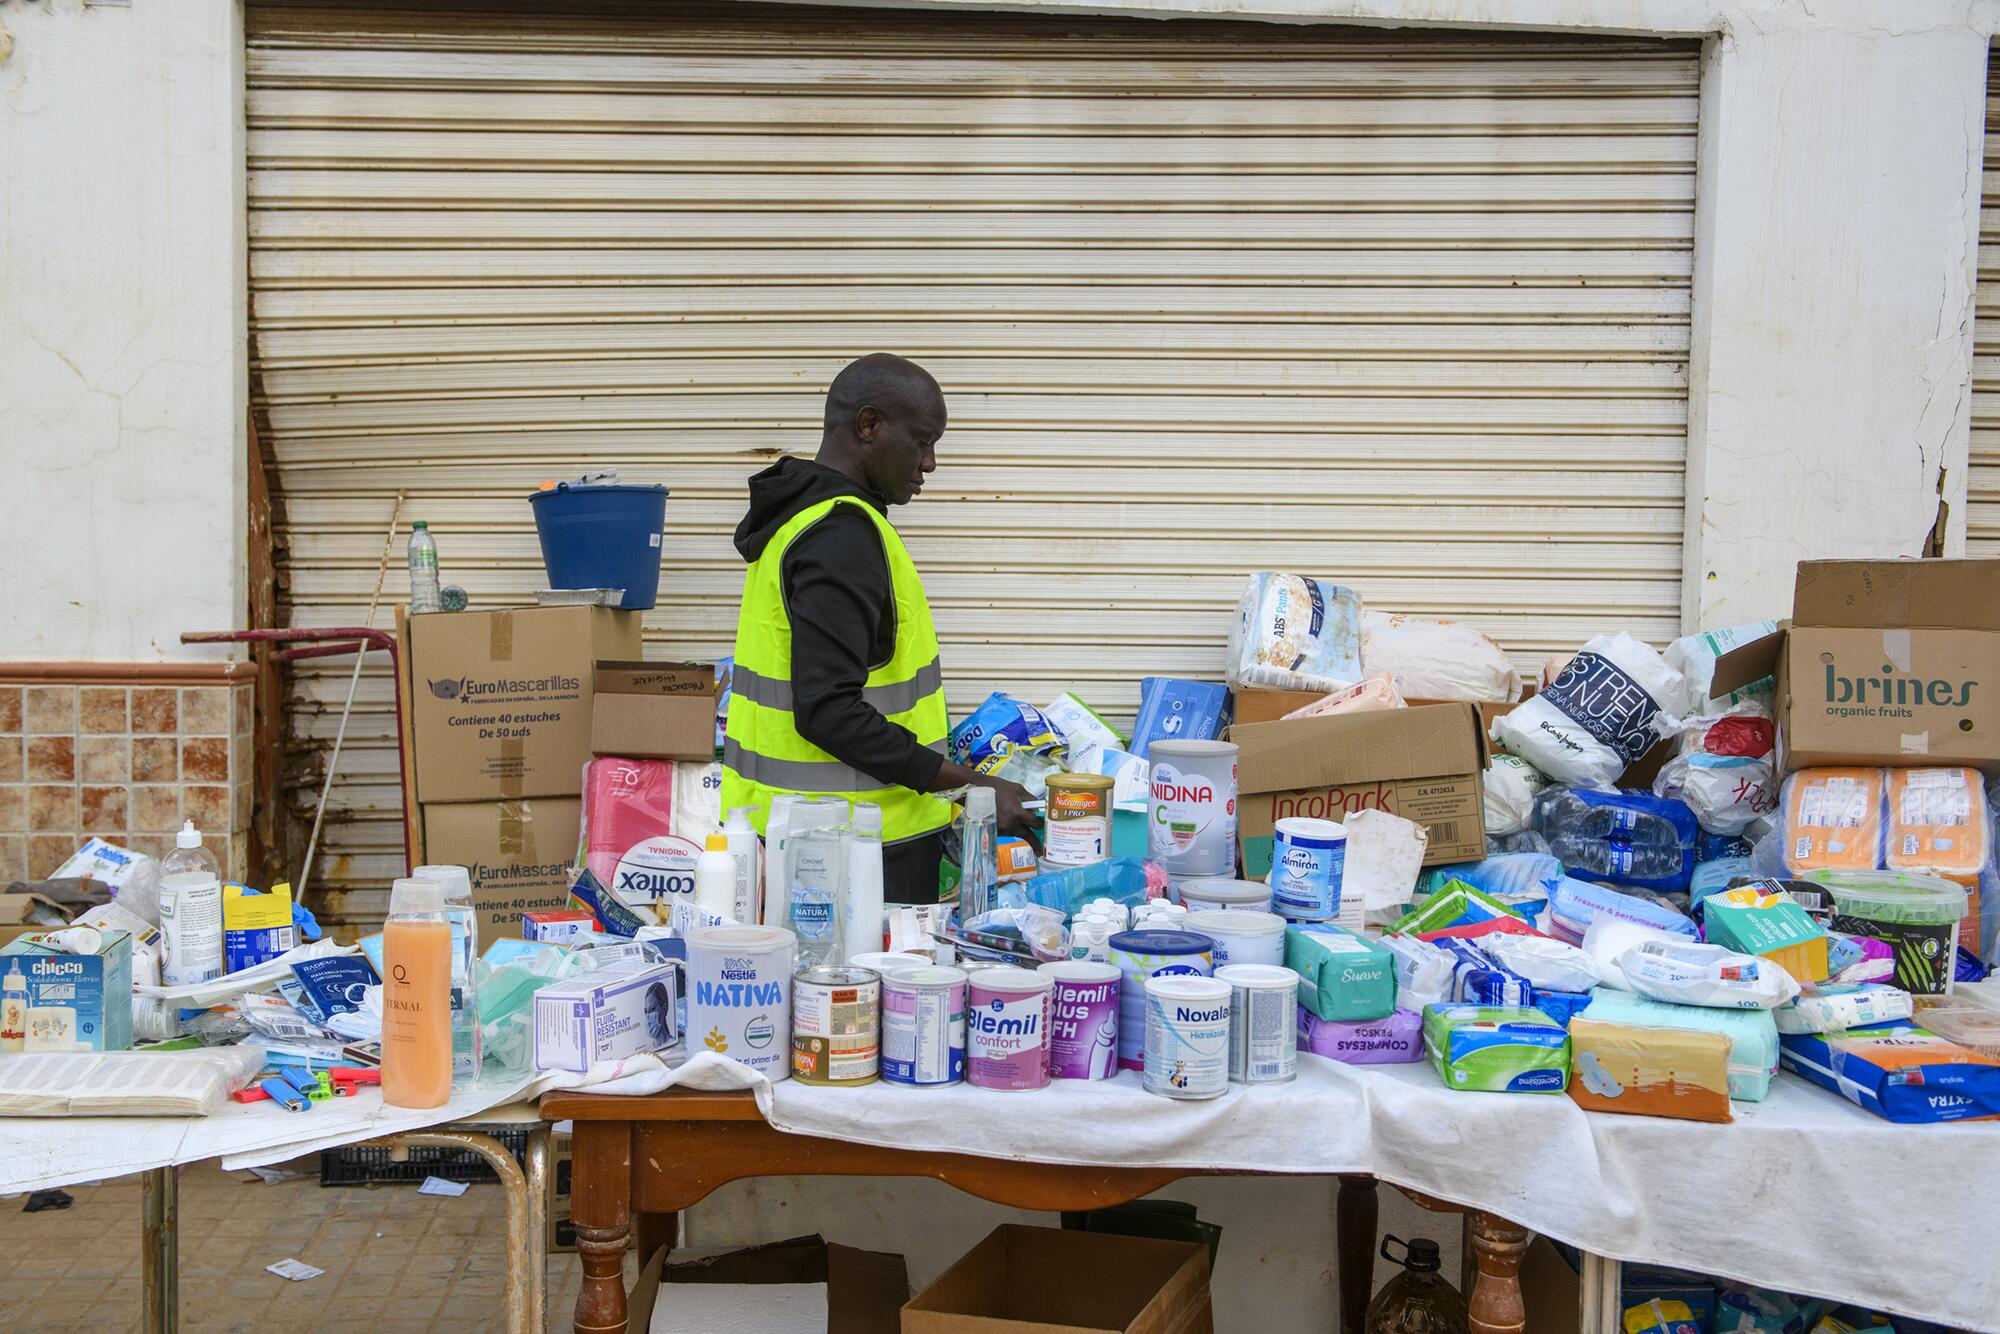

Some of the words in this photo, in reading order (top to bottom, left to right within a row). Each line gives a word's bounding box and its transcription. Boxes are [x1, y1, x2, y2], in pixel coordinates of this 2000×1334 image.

[1276, 587, 1288, 616] Pants
[1274, 614, 1286, 638] ABS
[466, 675, 580, 695] EuroMascarillas
[1826, 664, 1979, 707] brines
[554, 693, 580, 701] MANCHA
[448, 715, 496, 727] Contiene
[498, 714, 512, 724] 40
[514, 711, 561, 723] estuches
[1565, 700, 1604, 735] NUEVOS
[1570, 680, 1645, 751] NUEVO
[1826, 706, 1876, 718] organic
[1878, 706, 1913, 718] fruits
[479, 728, 494, 739] De
[496, 728, 510, 738] 50
[512, 727, 531, 737] uds
[951, 724, 984, 757] DODO
[703, 776, 722, 789] 48
[1151, 782, 1212, 803] NIDINA
[1271, 781, 1393, 823] IncoPack
[1068, 809, 1086, 817] PRO
[647, 846, 688, 856] ORIGINAL
[1094, 838, 1101, 854] 1
[480, 860, 575, 880] EuroMascarill
[1281, 855, 1319, 870] Almirón
[619, 872, 695, 899] cottex
[475, 900, 510, 911] ntiene
[511, 898, 525, 909] 40
[795, 908, 829, 916] NATURA
[492, 913, 505, 924] De
[507, 913, 523, 923] 50
[32, 957, 84, 976] chicco
[721, 969, 757, 980] Nestlé
[1341, 968, 1382, 983] Suave
[696, 981, 782, 1008] NATIVA
[596, 1013, 618, 1028] FLUID-
[968, 1007, 1037, 1035] Blemil
[1177, 1005, 1231, 1023] Novala
[597, 1017, 631, 1037] RESISTANT
[976, 1034, 1021, 1049] confort
[1337, 1040, 1409, 1051] COMPRESAS
[751, 1055, 771, 1065] primer
[1928, 1095, 1974, 1108] EXTRA
